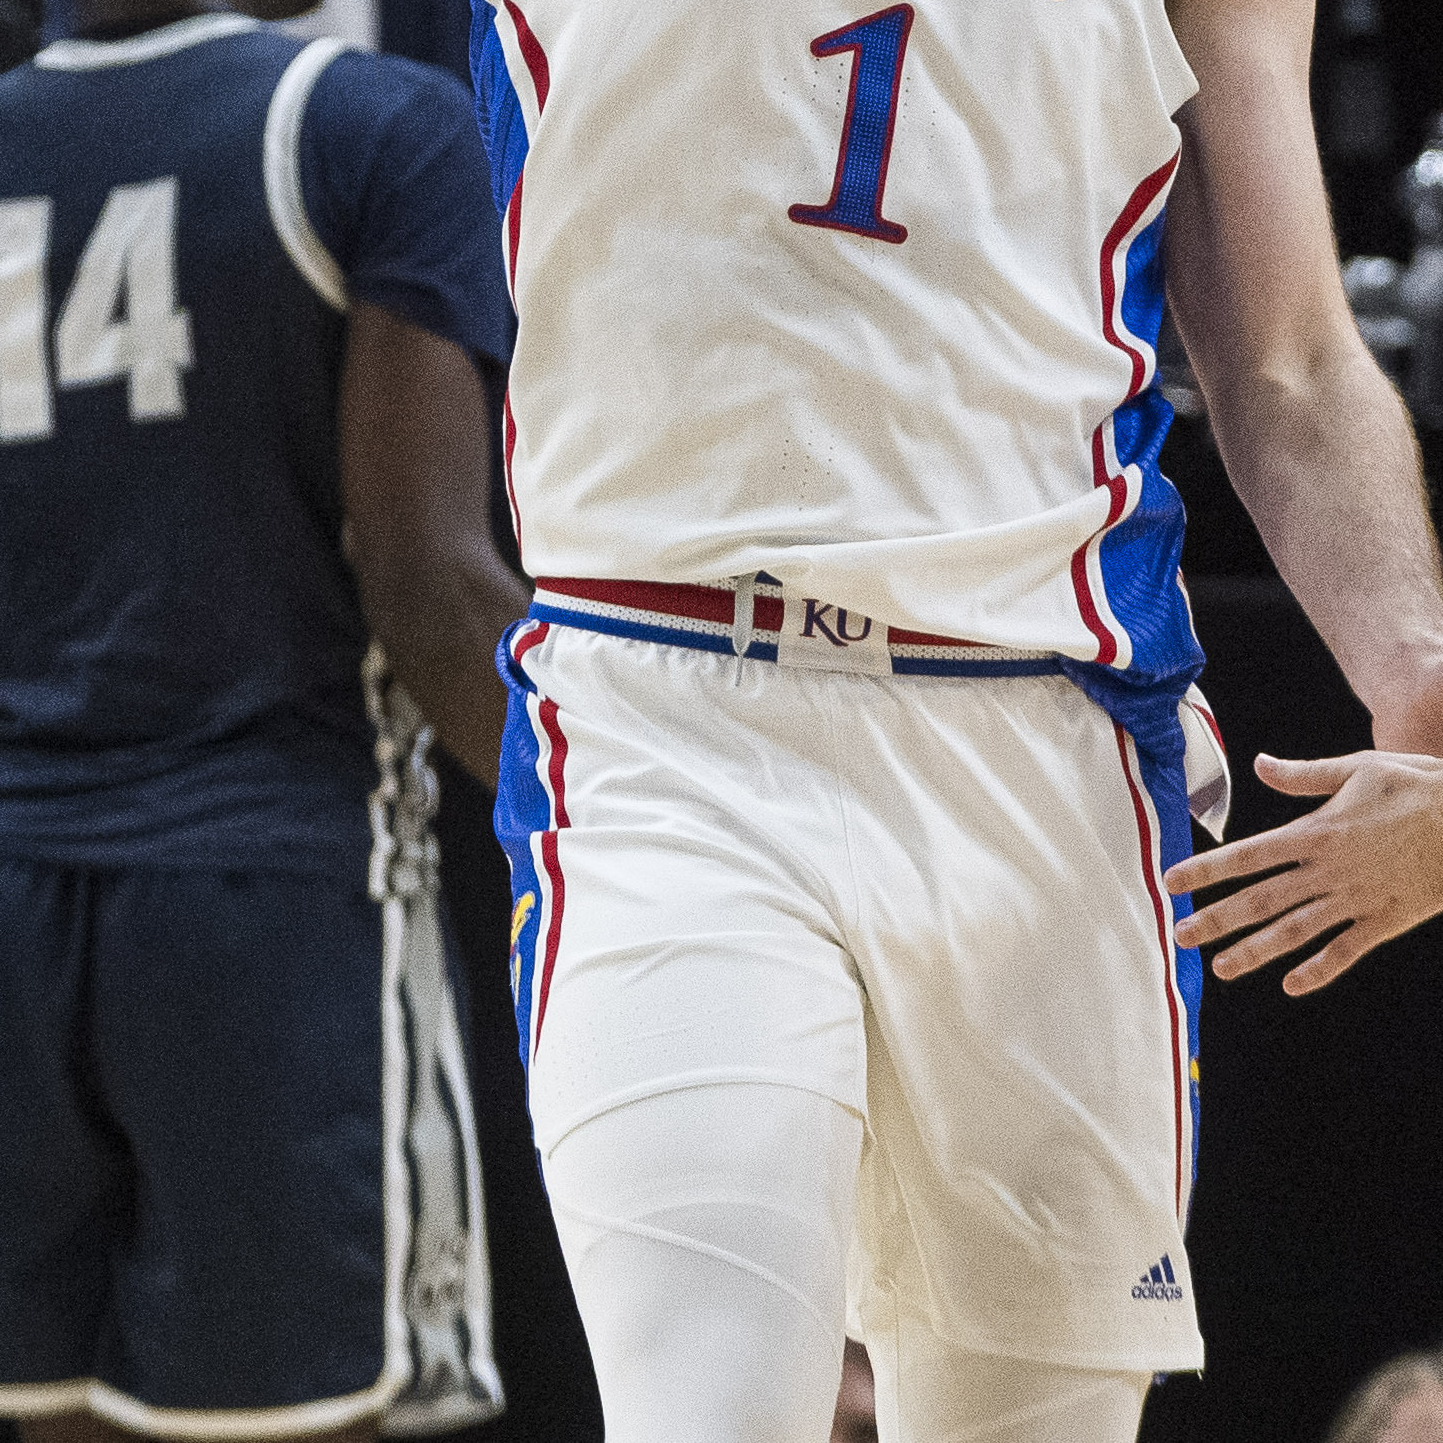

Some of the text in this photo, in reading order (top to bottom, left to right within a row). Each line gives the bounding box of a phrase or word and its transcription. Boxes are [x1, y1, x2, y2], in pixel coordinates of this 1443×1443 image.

[788, 2, 914, 244] 1
[799, 598, 872, 647] KU
[1131, 1282, 1183, 1302] adidas
